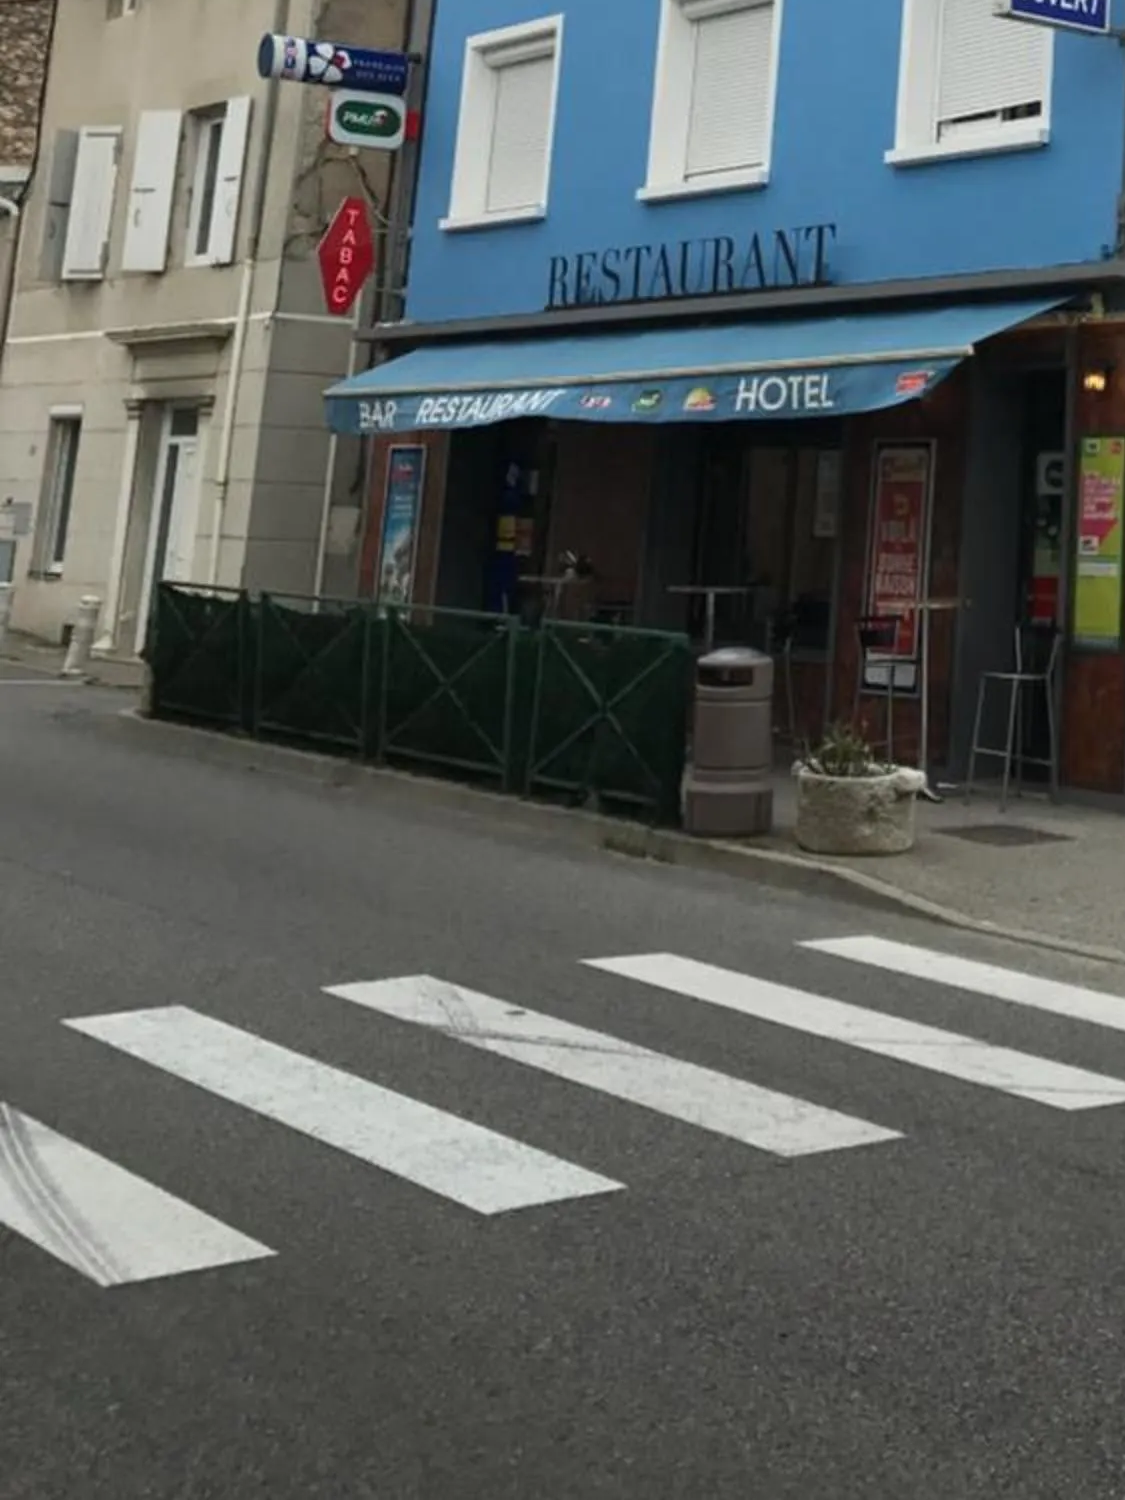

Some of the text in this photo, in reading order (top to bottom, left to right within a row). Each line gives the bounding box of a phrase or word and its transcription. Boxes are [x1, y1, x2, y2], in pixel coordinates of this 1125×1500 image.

[331, 208, 361, 304] TABAC
[546, 223, 837, 310] RESTAURANT
[358, 372, 834, 430] BAR RESTAURANT HOTEL
